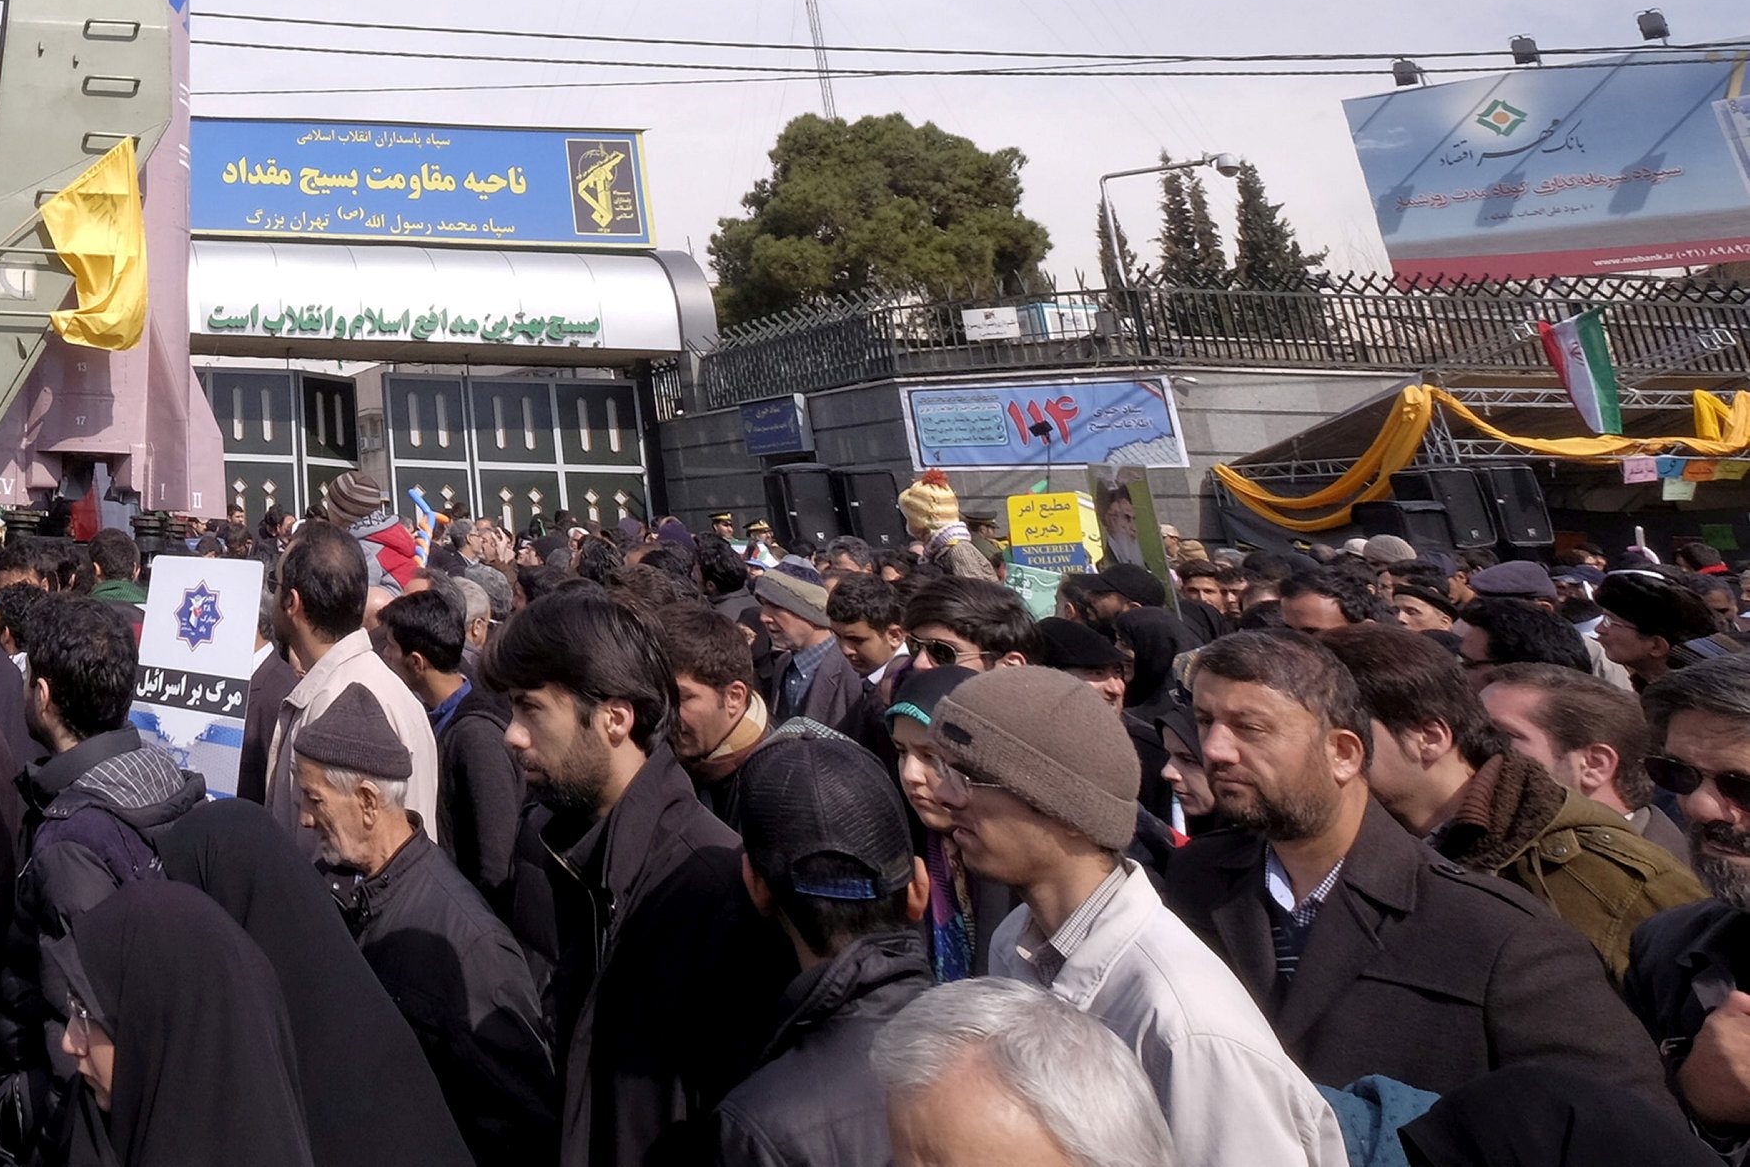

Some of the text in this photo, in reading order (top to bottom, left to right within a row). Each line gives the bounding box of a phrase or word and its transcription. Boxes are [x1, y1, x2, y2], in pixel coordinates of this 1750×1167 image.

[296, 129, 451, 149] سپاه پاسداران انقلاب اسلامی
[1439, 118, 1586, 167] بانک مهر اقتصاد
[221, 156, 528, 201] ناحیه مقاومت بسیج مقداد
[245, 208, 286, 230] بزرگ
[289, 211, 331, 231] تهران
[364, 212, 385, 229] الله
[389, 214, 433, 235] رسول
[436, 219, 477, 232] محمد
[481, 217, 516, 239] سپاه
[207, 303, 601, 347] بسیج بهترین مدافع اسلام و انقلاب است
[76, 361, 88, 372] 13
[75, 415, 87, 426] 17
[1007, 395, 1080, 448] ۱۱۴
[192, 492, 203, 509] II
[1018, 498, 1071, 519] مطیع امر
[1024, 523, 1065, 541] رهبریم
[1022, 544, 1077, 555] SINCERELY
[1028, 554, 1072, 565] FOLLOW
[135, 668, 243, 713] مرگ بر اسرائیل
